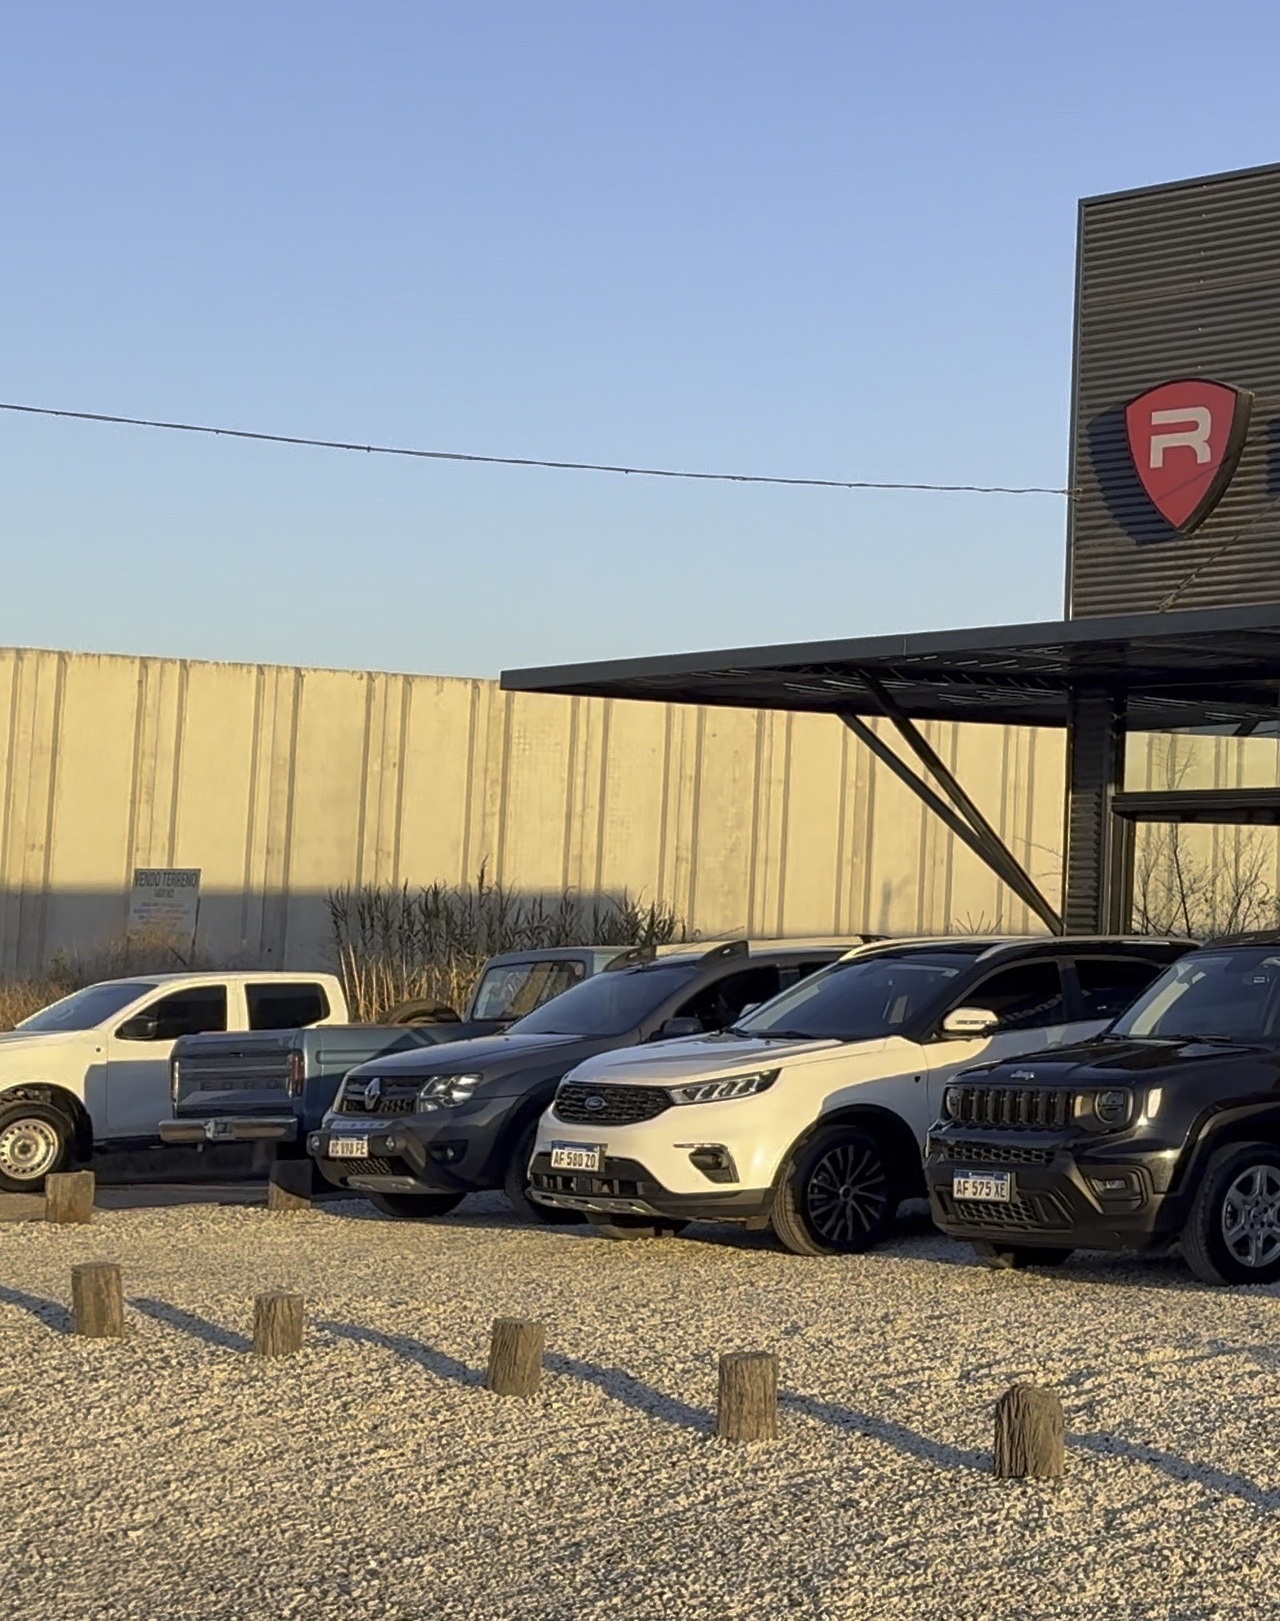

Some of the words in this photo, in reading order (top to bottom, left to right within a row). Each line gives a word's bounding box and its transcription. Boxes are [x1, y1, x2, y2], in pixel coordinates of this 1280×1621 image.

[1150, 406, 1212, 468] R
[956, 1180, 969, 1196] AF
[972, 1181, 992, 1198] 575
[994, 1182, 1006, 1198] XE
